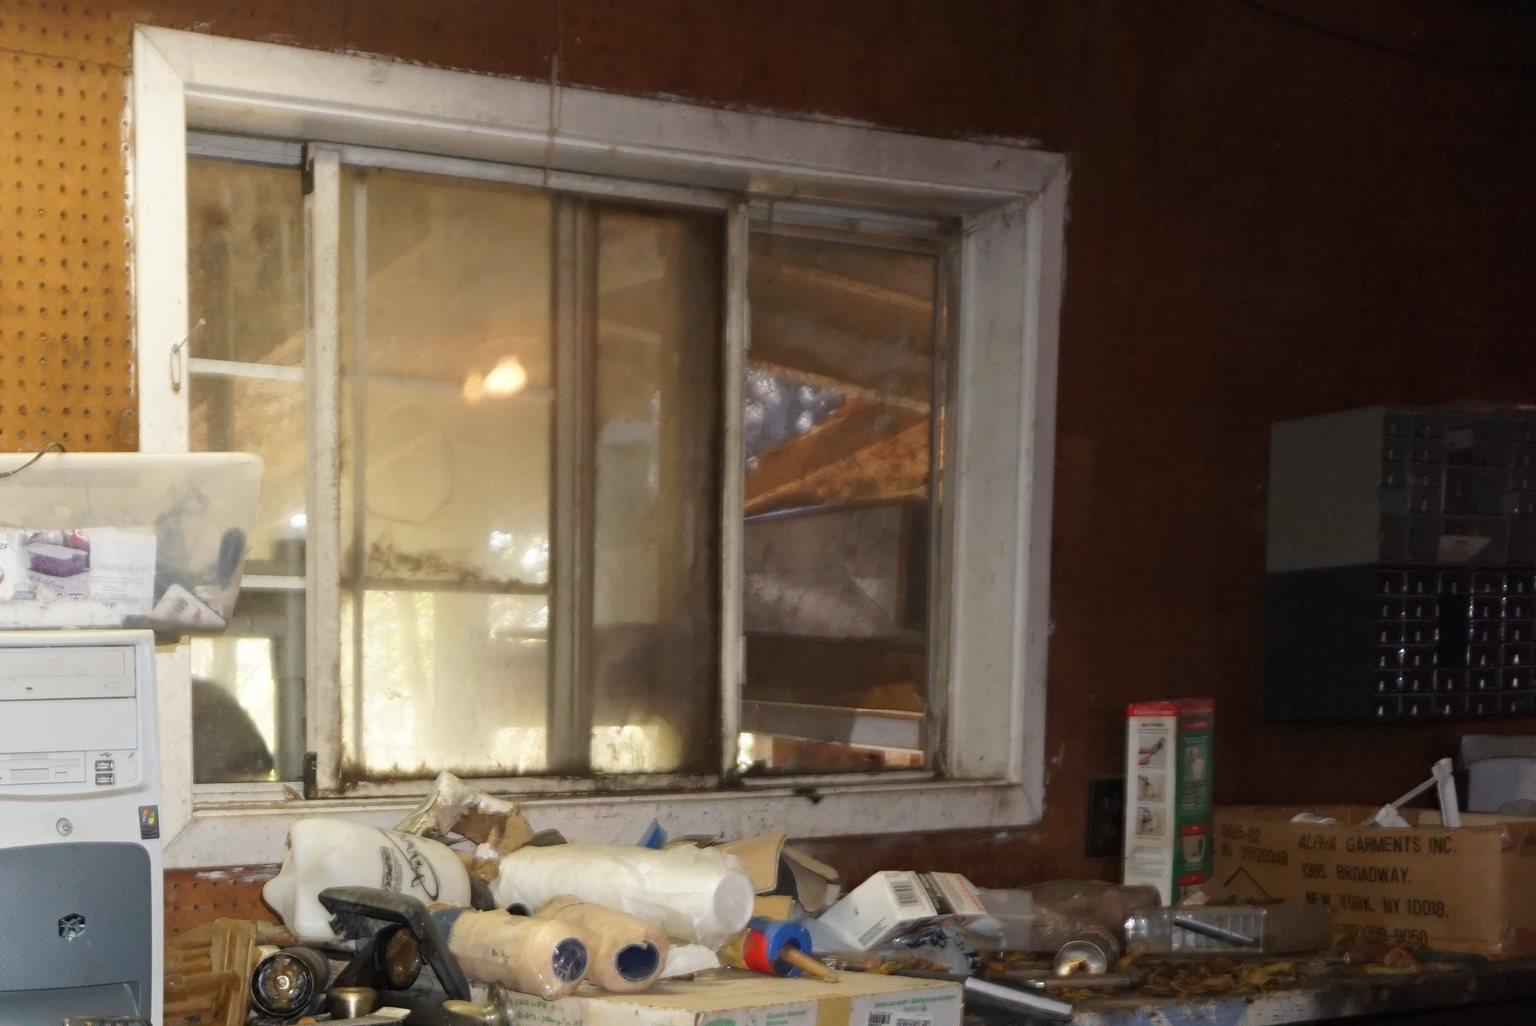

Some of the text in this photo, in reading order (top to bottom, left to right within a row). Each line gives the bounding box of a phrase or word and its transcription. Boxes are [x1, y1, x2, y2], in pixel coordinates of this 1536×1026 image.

[1299, 834, 1336, 851] ALPHA
[1346, 836, 1422, 853] GARMENTS
[1384, 898, 1400, 914] NY
